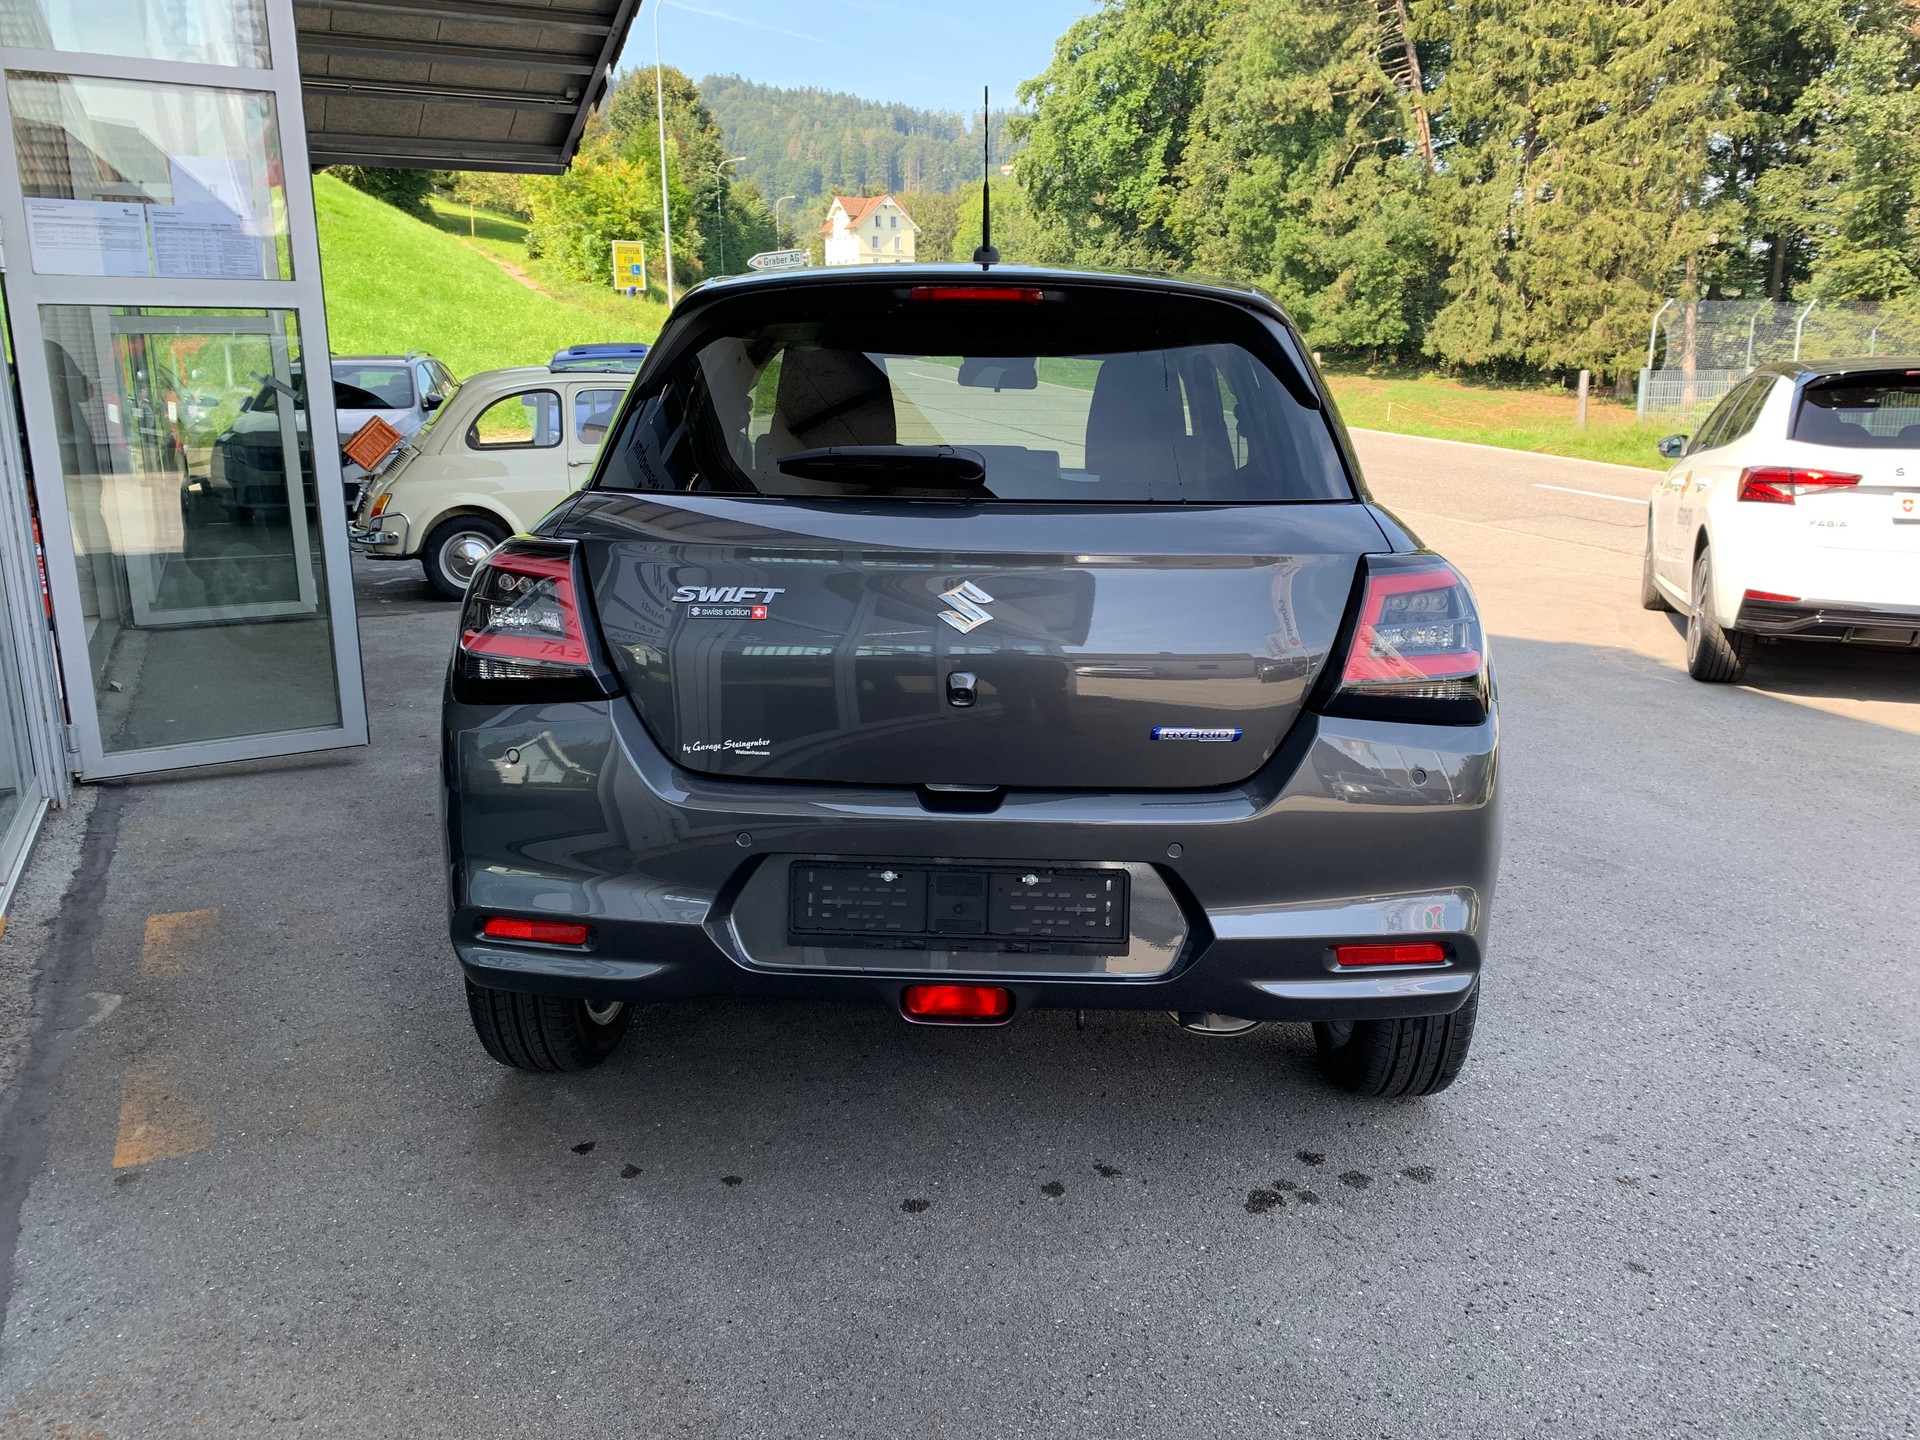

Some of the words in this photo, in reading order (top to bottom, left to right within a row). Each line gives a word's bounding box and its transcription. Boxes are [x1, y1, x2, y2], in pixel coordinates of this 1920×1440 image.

[763, 256, 788, 266] Graber
[789, 253, 800, 263] AG
[1810, 520, 1847, 528] FABIA
[671, 585, 786, 604] SWIFT
[701, 607, 724, 616] swiss
[724, 607, 751, 616] edition
[1164, 731, 1229, 740] HYBRID
[682, 743, 691, 754] by
[692, 741, 722, 752] Garage
[722, 737, 770, 750] Steingruber
